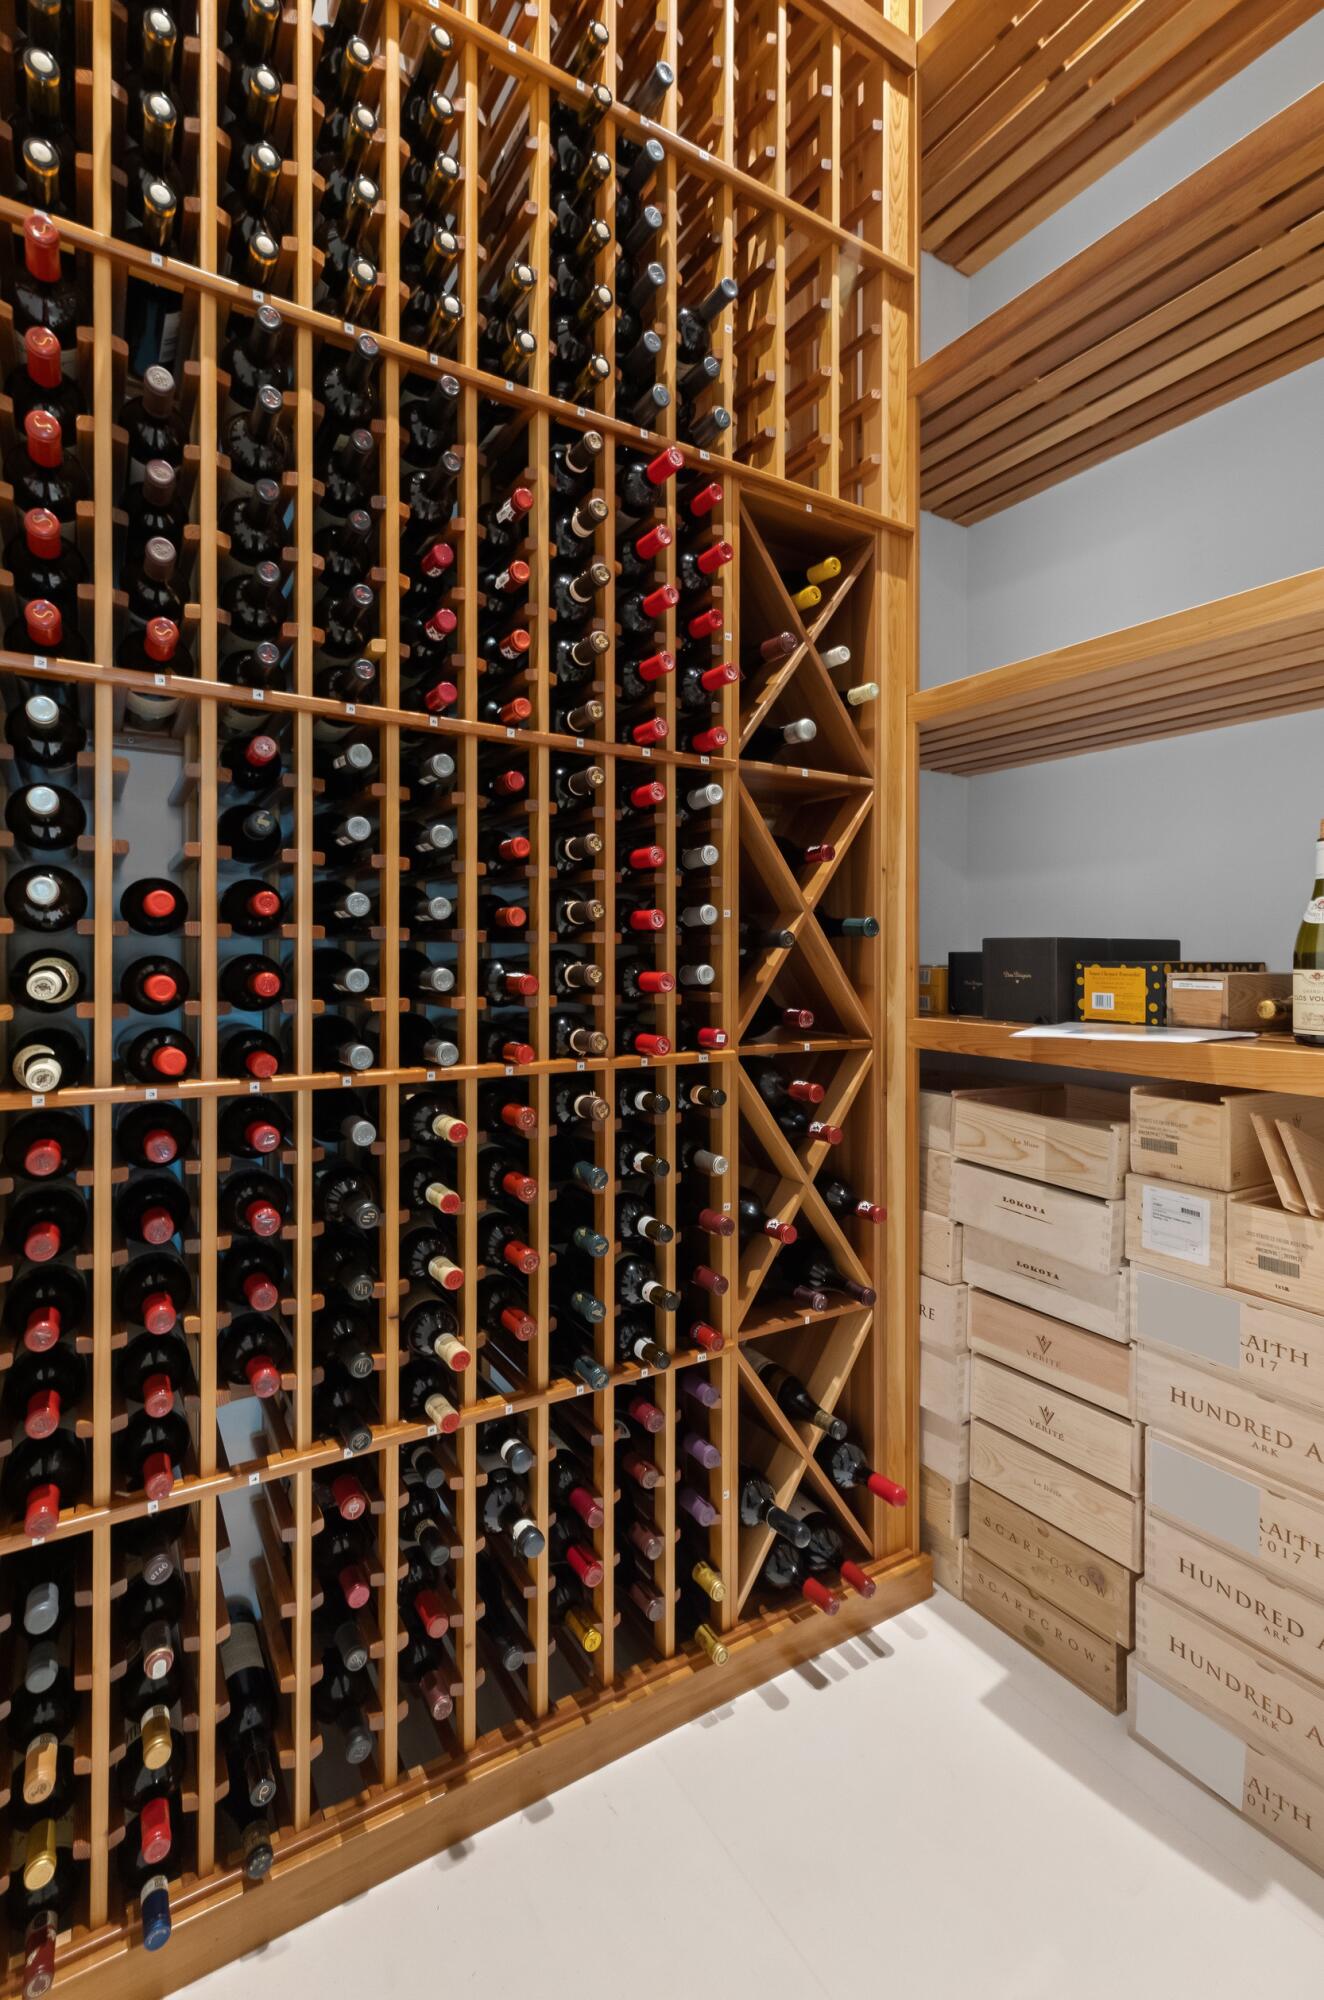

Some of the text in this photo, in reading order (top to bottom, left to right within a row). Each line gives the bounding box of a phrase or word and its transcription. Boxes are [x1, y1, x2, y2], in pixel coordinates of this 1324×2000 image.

[1002, 1196, 1046, 1215] LOKOYA
[1016, 1260, 1060, 1281] LOKOYA
[1240, 1334, 1309, 1368] AITH
[1170, 1385, 1293, 1449] HUNDRED
[1252, 1441, 1279, 1458] ARK
[983, 1516, 1106, 1598] SCARECROW
[1179, 1556, 1304, 1638] HUNDRED
[977, 1573, 1097, 1663] SCARECROW
[1263, 1625, 1289, 1645] ARK
[1169, 1633, 1294, 1726] HUNDRED
[1252, 1710, 1279, 1732] ARK
